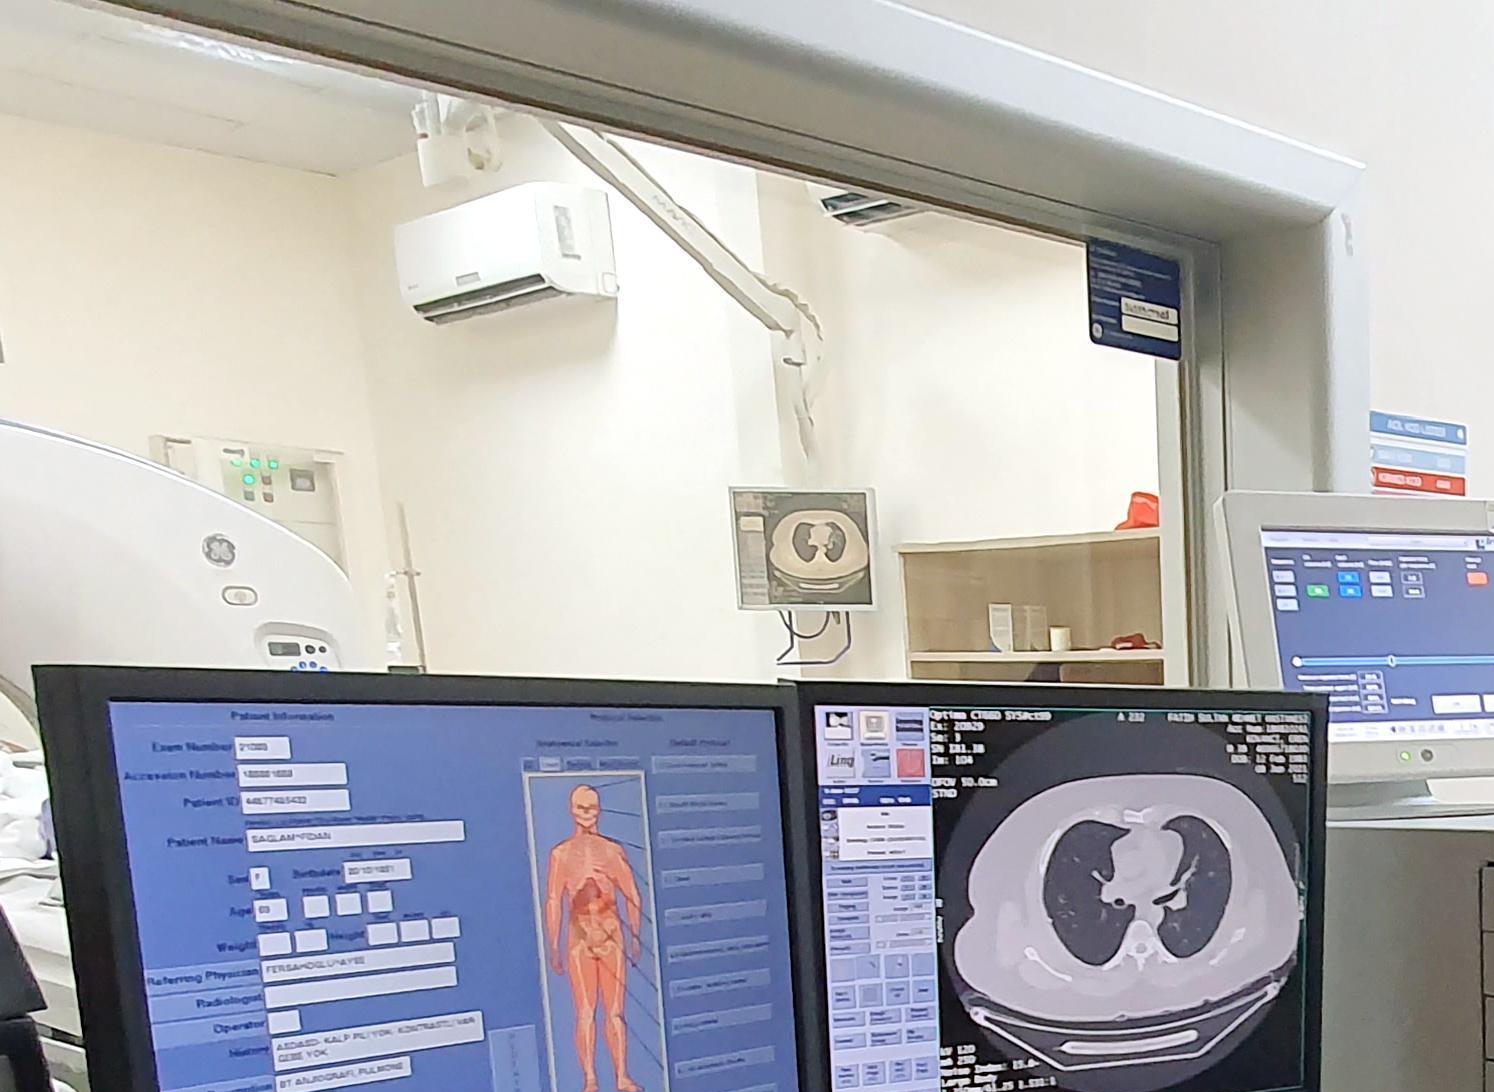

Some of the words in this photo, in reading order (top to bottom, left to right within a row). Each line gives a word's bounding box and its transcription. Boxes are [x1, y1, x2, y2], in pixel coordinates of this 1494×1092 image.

[231, 711, 270, 721] Patient
[167, 836, 209, 849] Patient
[213, 1020, 265, 1034] Operator
